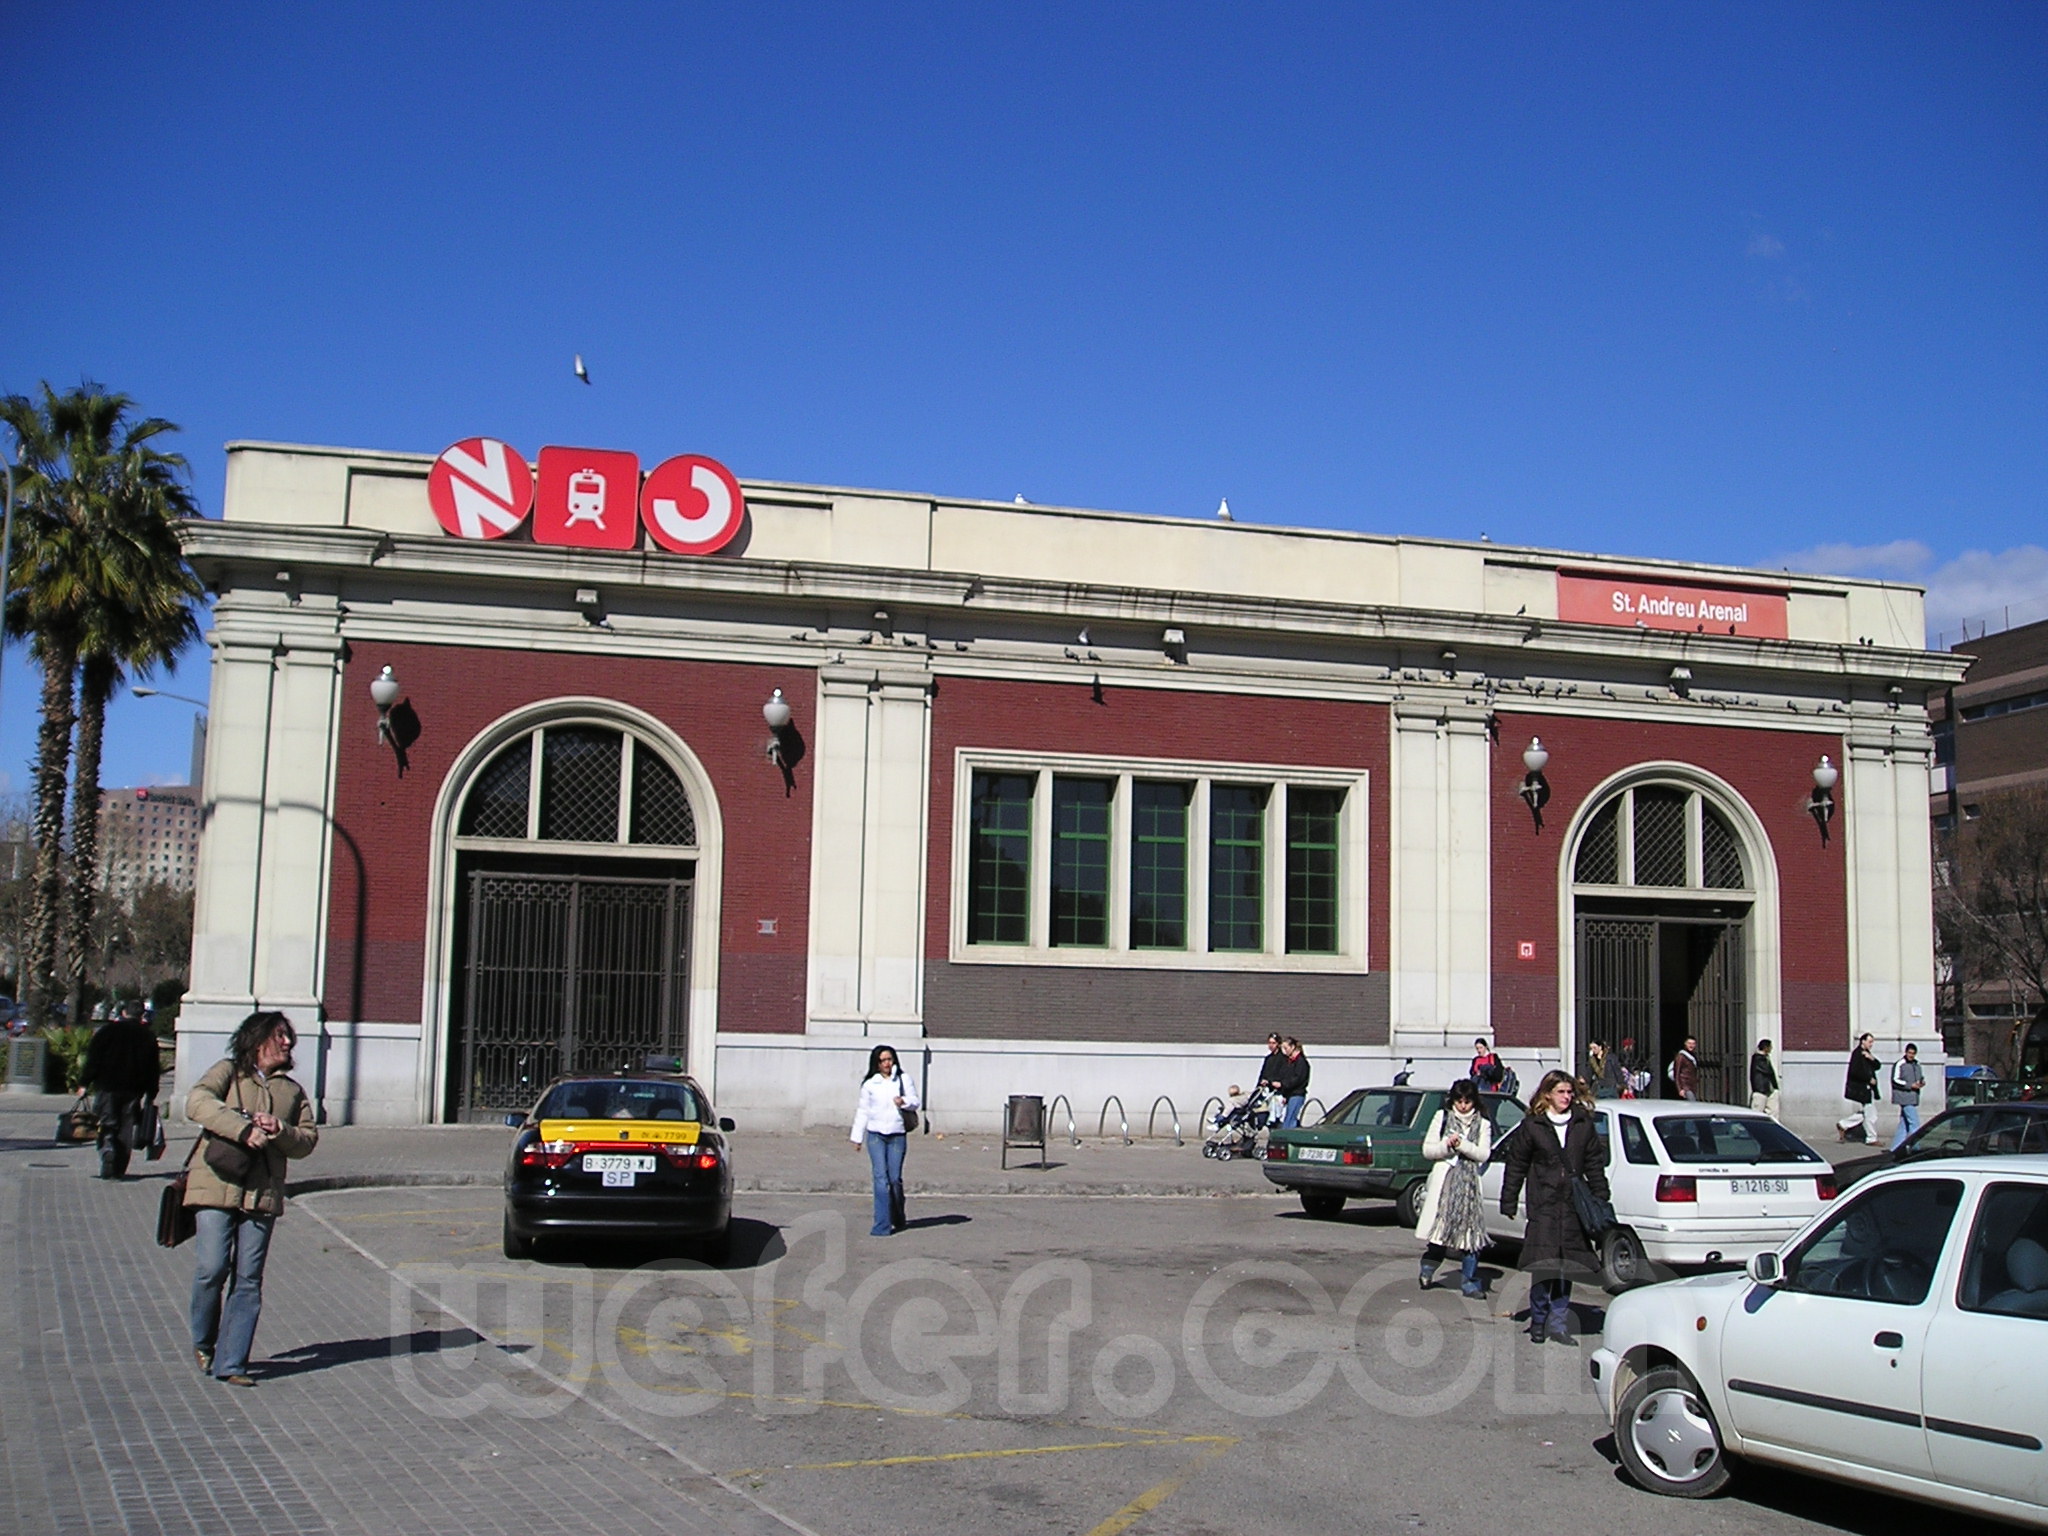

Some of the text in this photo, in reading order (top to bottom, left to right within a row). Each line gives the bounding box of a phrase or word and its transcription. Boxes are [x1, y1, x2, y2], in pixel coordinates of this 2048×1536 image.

[1612, 591, 1747, 622] St. Andreu Arenal
[606, 1172, 631, 1184] SP
